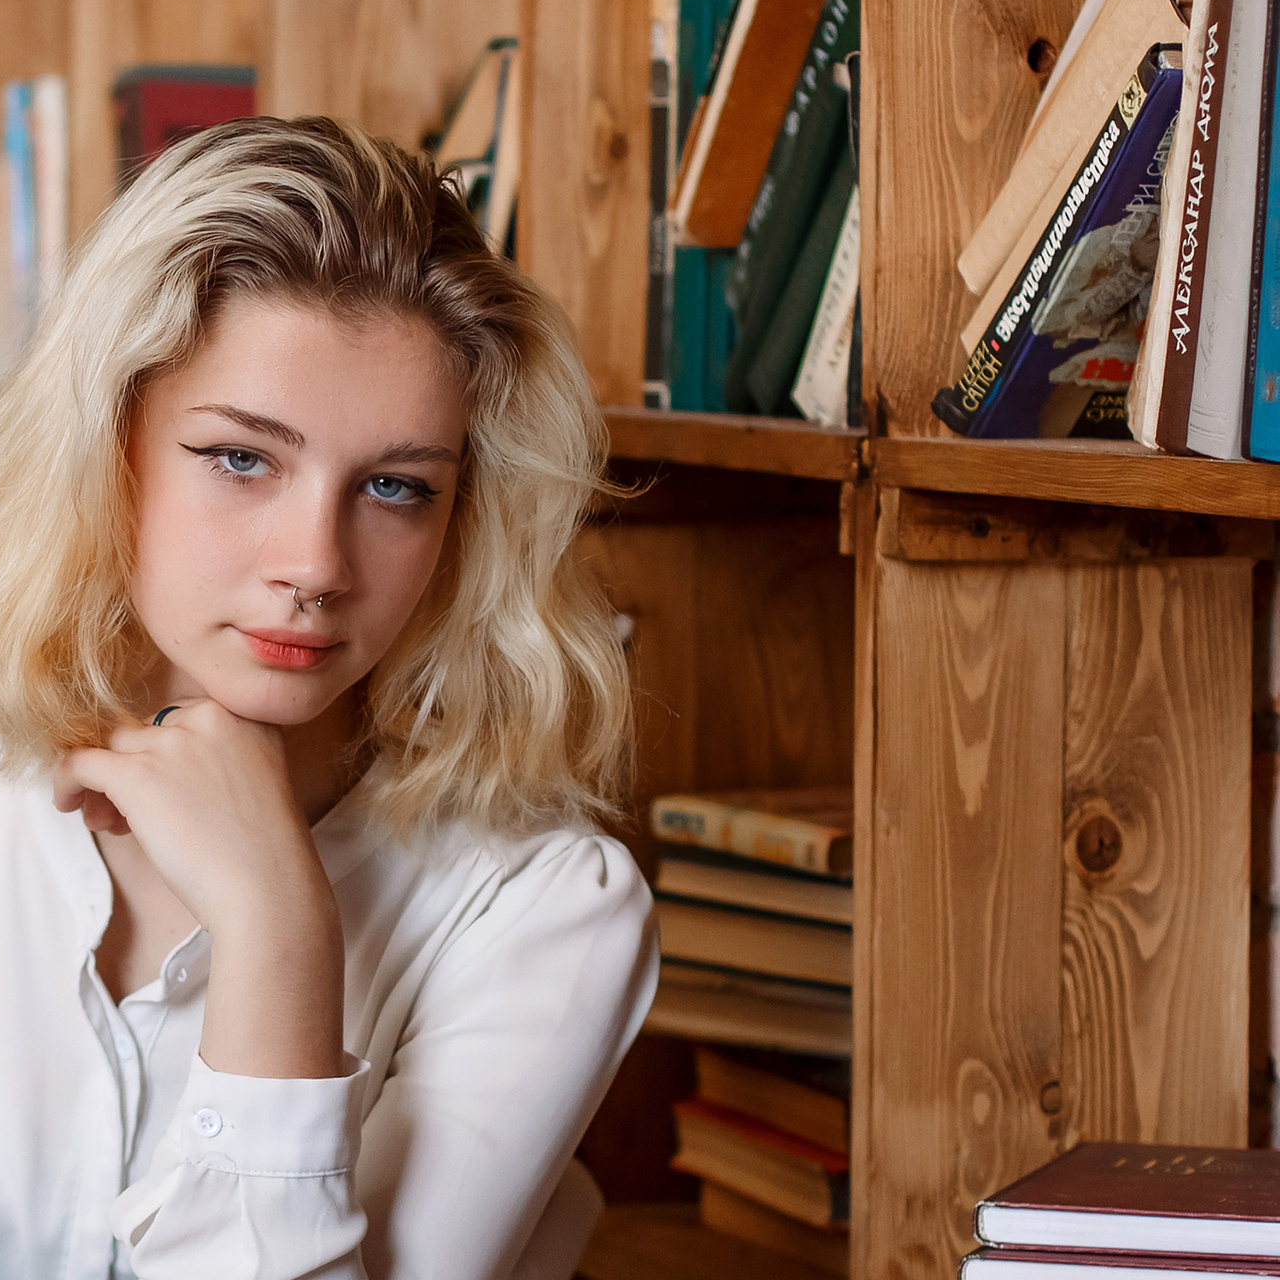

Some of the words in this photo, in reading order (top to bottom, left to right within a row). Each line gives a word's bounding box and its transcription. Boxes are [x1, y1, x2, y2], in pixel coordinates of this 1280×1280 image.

[1170, 148, 1207, 356] АЛЕКСАНДР
[1197, 21, 1219, 142] ДЮМА
[963, 353, 1003, 415] САТТОН
